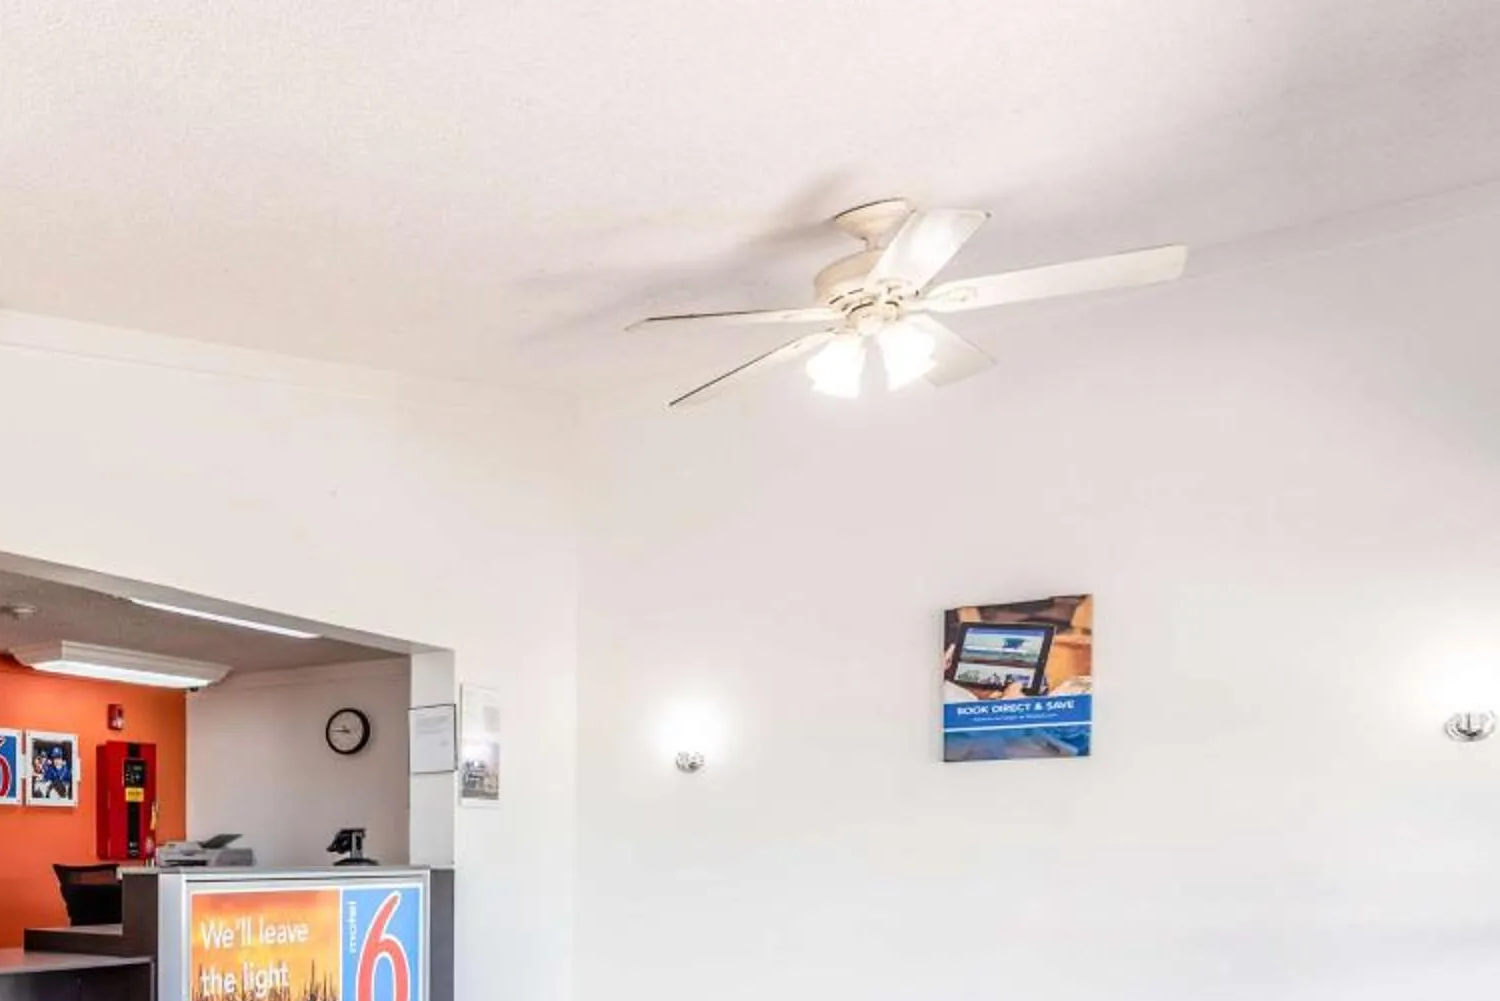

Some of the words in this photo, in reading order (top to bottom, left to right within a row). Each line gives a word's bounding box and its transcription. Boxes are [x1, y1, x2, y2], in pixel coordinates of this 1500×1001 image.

[957, 706, 989, 716] BOOK
[991, 702, 1032, 714] DIRECT
[1046, 699, 1075, 711] SAVE
[200, 919, 251, 948] We'll
[258, 916, 310, 944] leave
[200, 967, 236, 996] the
[243, 962, 290, 998] light
